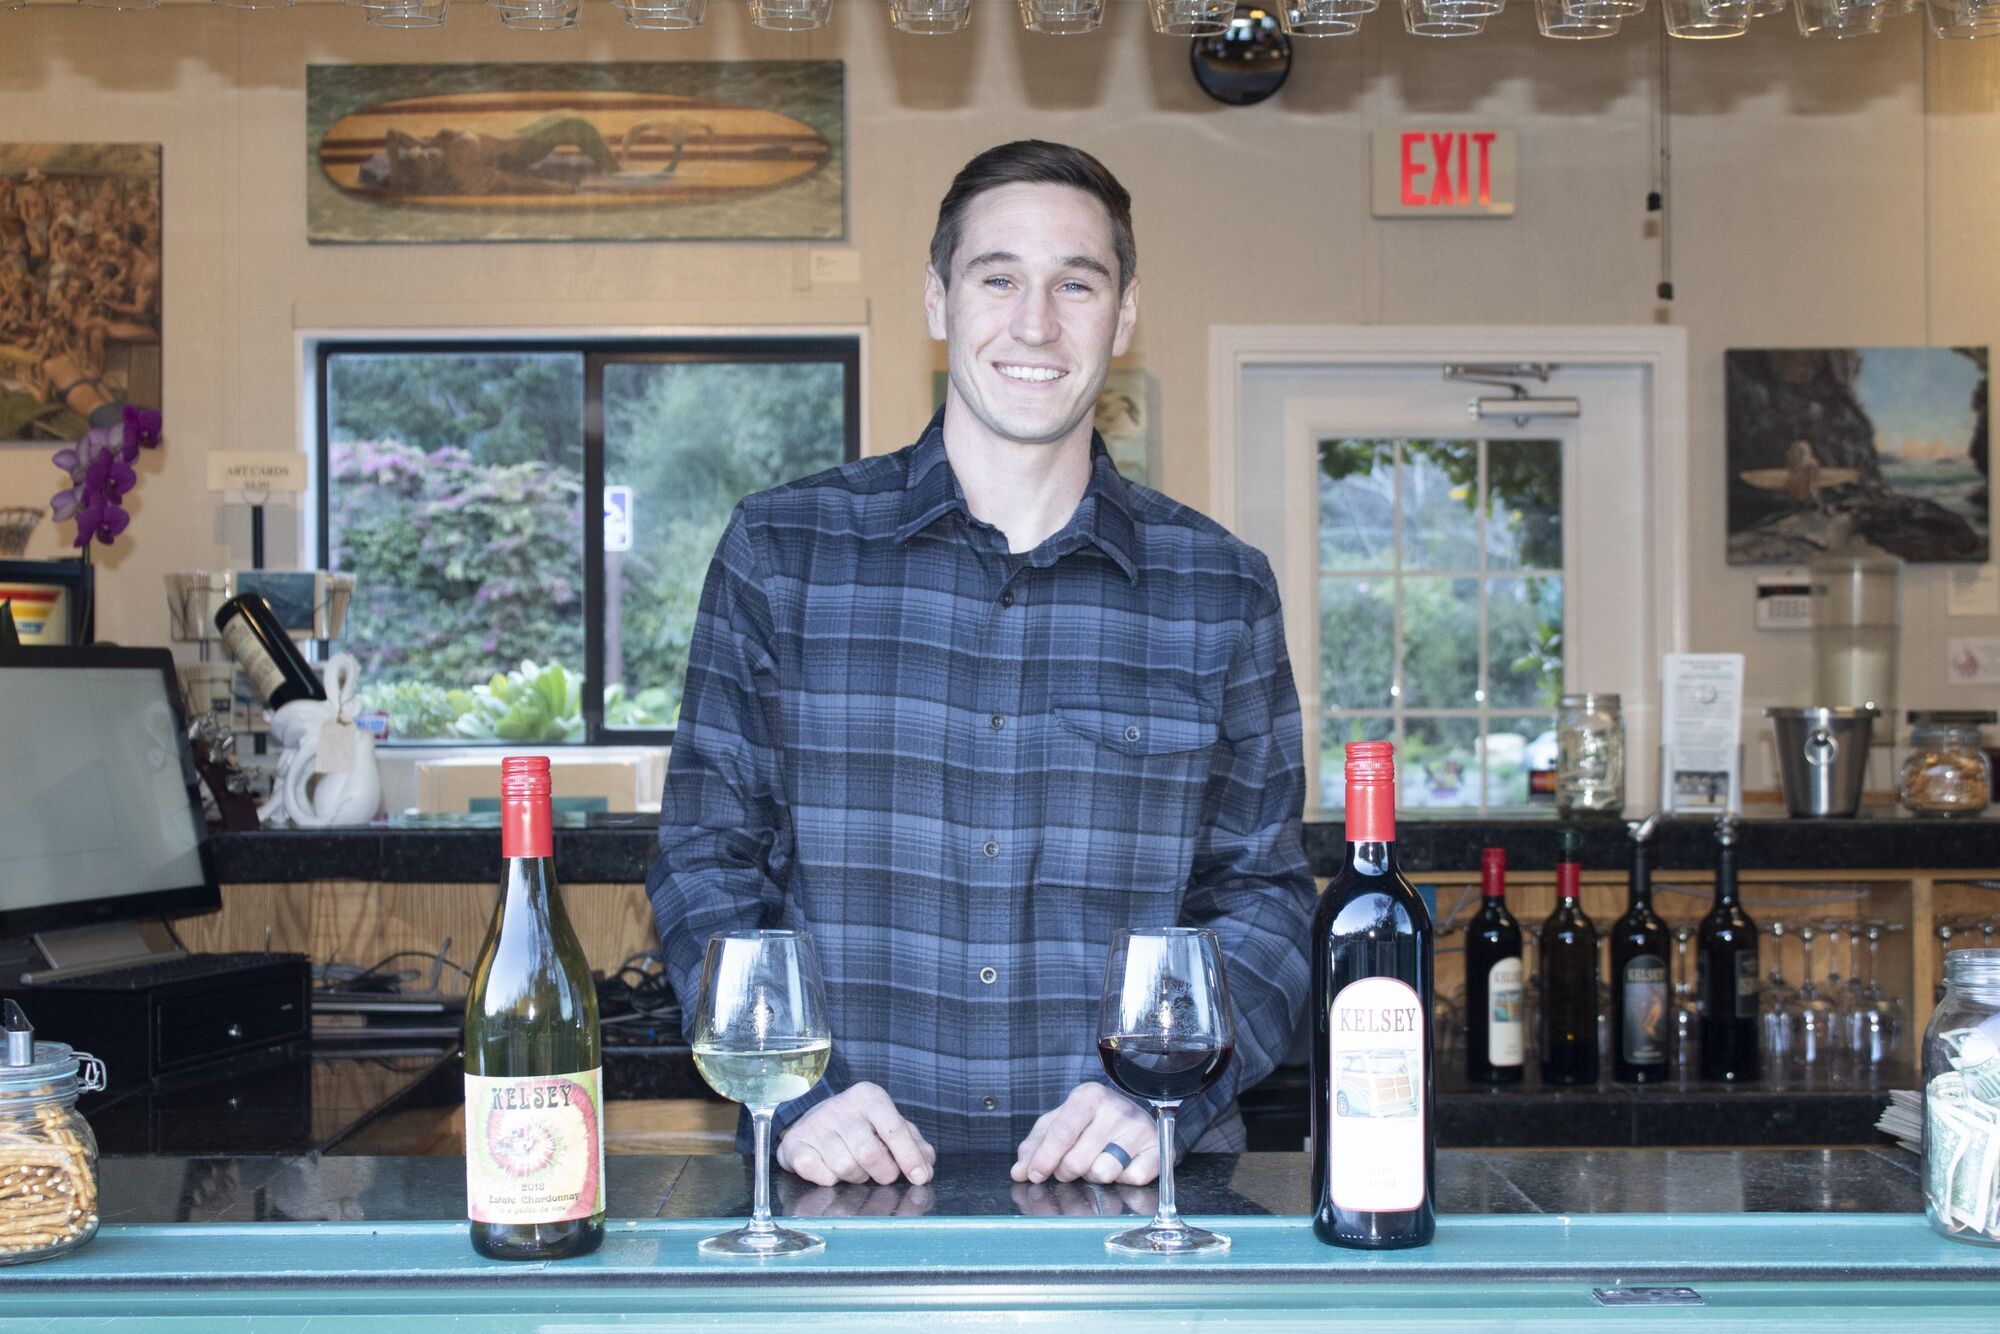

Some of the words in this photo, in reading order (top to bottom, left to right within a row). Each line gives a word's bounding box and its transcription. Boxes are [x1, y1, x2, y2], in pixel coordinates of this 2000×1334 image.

[1401, 132, 1496, 206] EXIT
[226, 465, 248, 477] ART
[249, 465, 289, 477] CARDS
[1340, 1008, 1416, 1032] KELSEY
[492, 1085, 572, 1110] KELSEY
[489, 1195, 516, 1204] Estate
[521, 1192, 580, 1204] Chardonnay
